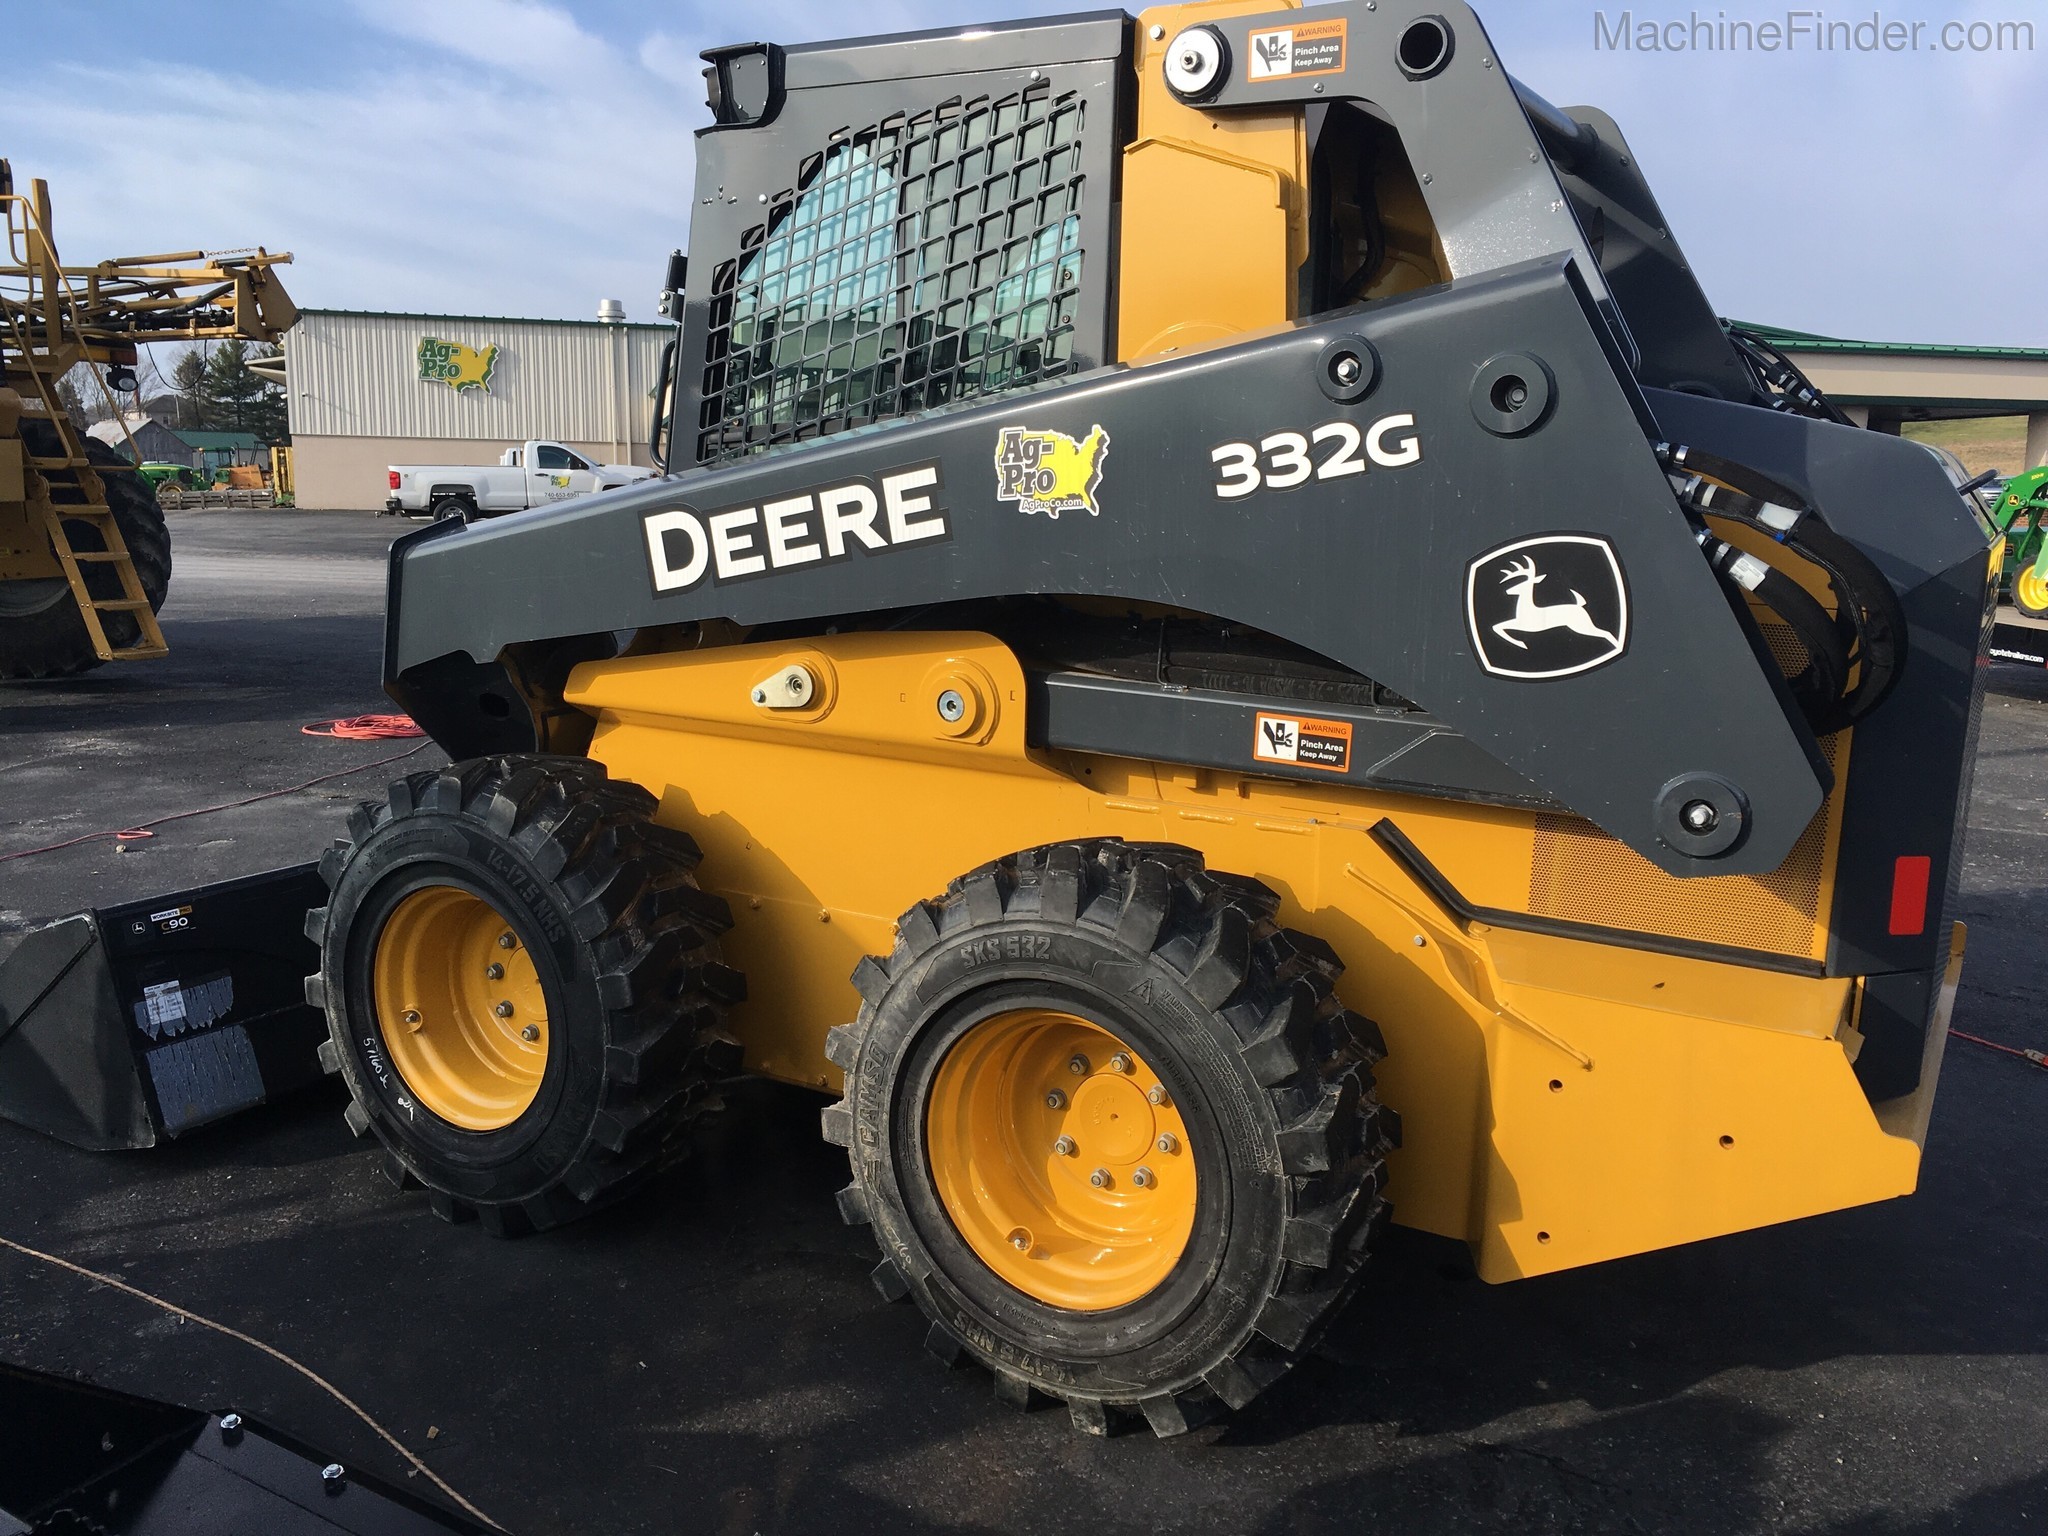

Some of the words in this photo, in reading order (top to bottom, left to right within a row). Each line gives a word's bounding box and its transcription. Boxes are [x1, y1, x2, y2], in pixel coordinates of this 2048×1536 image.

[1304, 25, 1341, 35] WARNING
[1295, 47, 1318, 56] Pinch
[1319, 44, 1339, 53] Area
[1294, 58, 1312, 67] Keep
[1313, 55, 1332, 65] Away
[420, 337, 460, 362] Ag-
[421, 358, 461, 379] Pro
[1001, 430, 1054, 469] Ag-
[1212, 415, 1421, 500] 332G
[1001, 464, 1056, 498] Pro
[1022, 498, 1083, 511] AgProCo.com
[643, 467, 946, 591] DEERE
[1989, 648, 2044, 663] oyotetrailers.com
[1311, 724, 1346, 735] WARNING
[1301, 739, 1323, 749] Pinch
[1324, 743, 1343, 752] Area
[1299, 749, 1317, 759] Keep
[1318, 752, 1337, 762] Away
[152, 911, 178, 920] WORKSITE
[534, 899, 566, 943] NHS
[161, 917, 188, 931] C90
[960, 938, 1001, 969] SKS
[1006, 935, 1051, 960] 532
[859, 1039, 891, 1149] CAMSO
